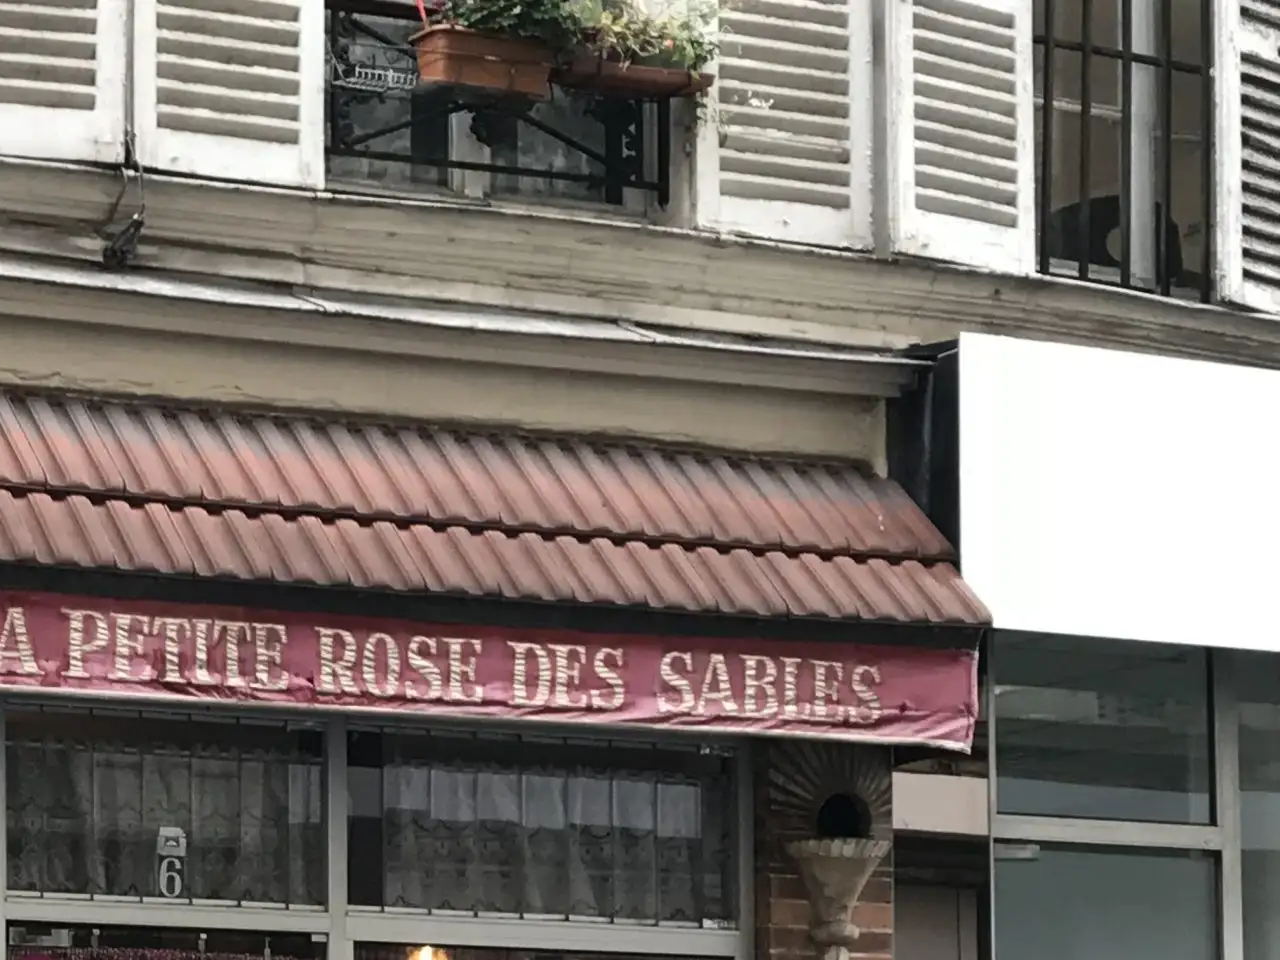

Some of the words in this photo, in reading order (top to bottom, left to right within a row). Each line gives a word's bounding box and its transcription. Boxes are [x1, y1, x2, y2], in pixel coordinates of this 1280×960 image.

[60, 606, 290, 692] PETITE
[314, 626, 483, 704] ROSE
[506, 640, 625, 711] DES
[656, 649, 883, 725] SABLES
[160, 857, 182, 897] 6
